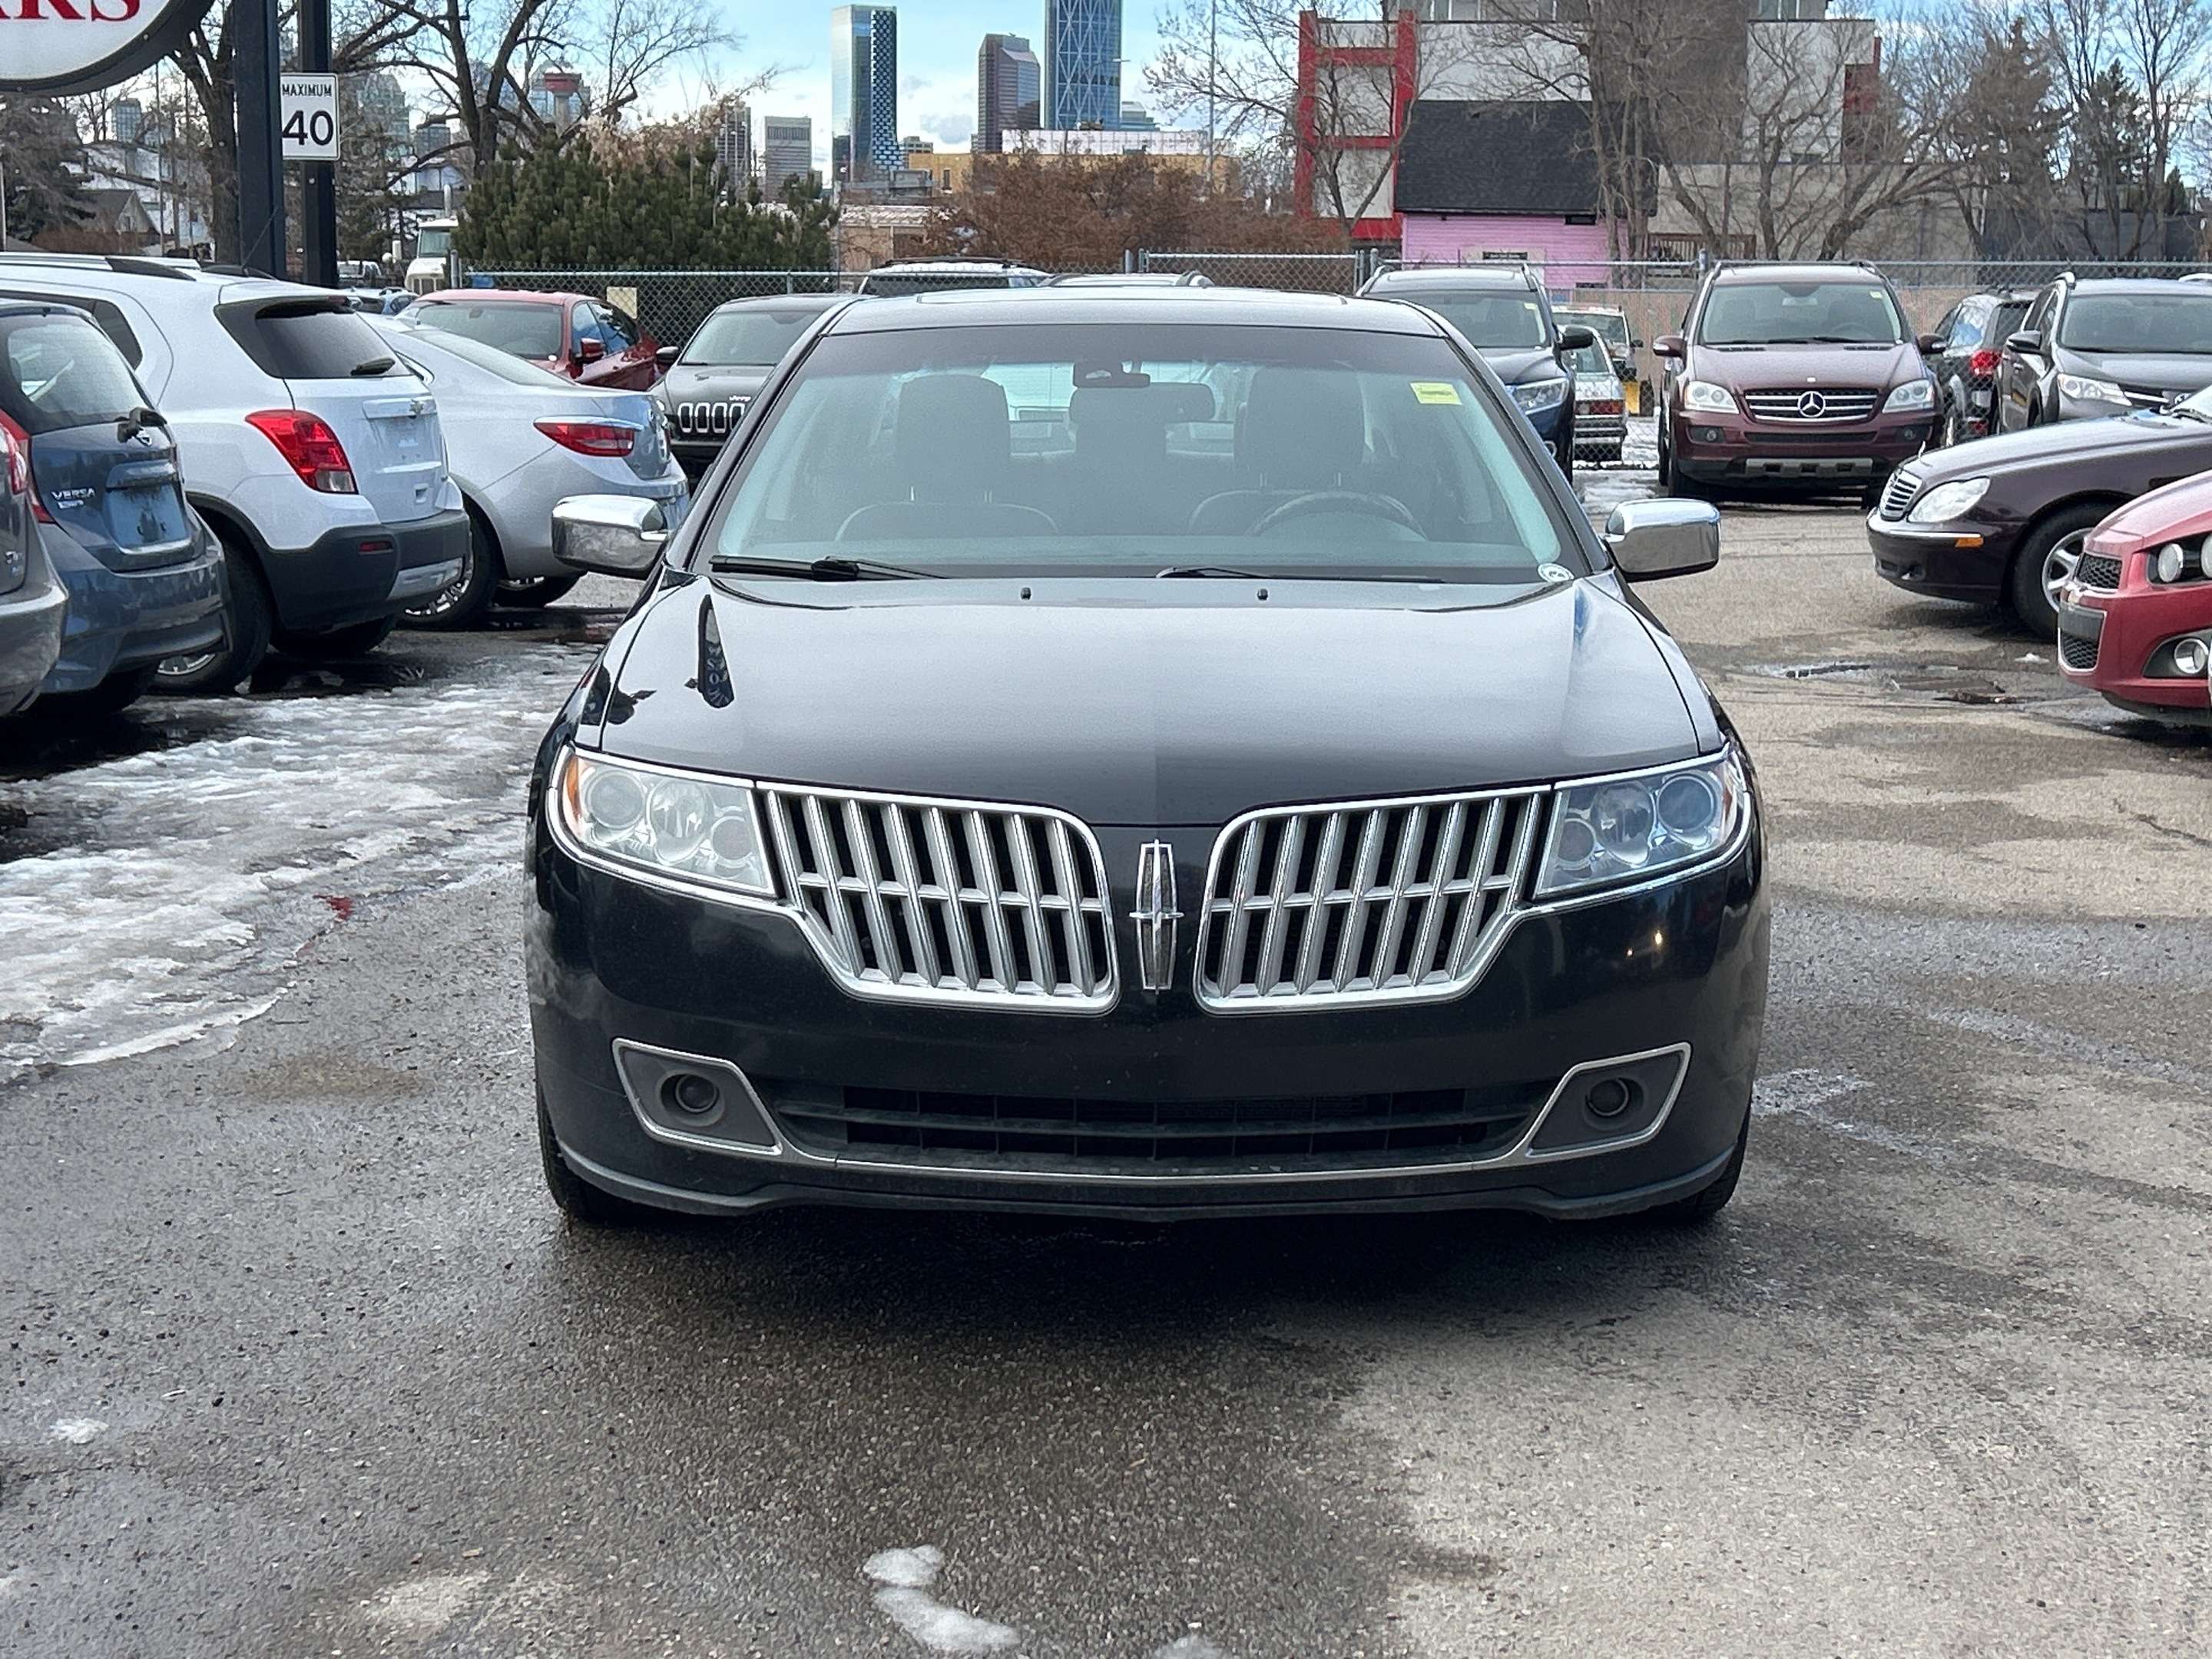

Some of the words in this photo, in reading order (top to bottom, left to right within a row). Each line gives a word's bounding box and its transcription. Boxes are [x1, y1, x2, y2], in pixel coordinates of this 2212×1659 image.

[282, 84, 333, 97] MAXIMUM
[282, 110, 334, 146] 40
[51, 488, 96, 500] VERSA
